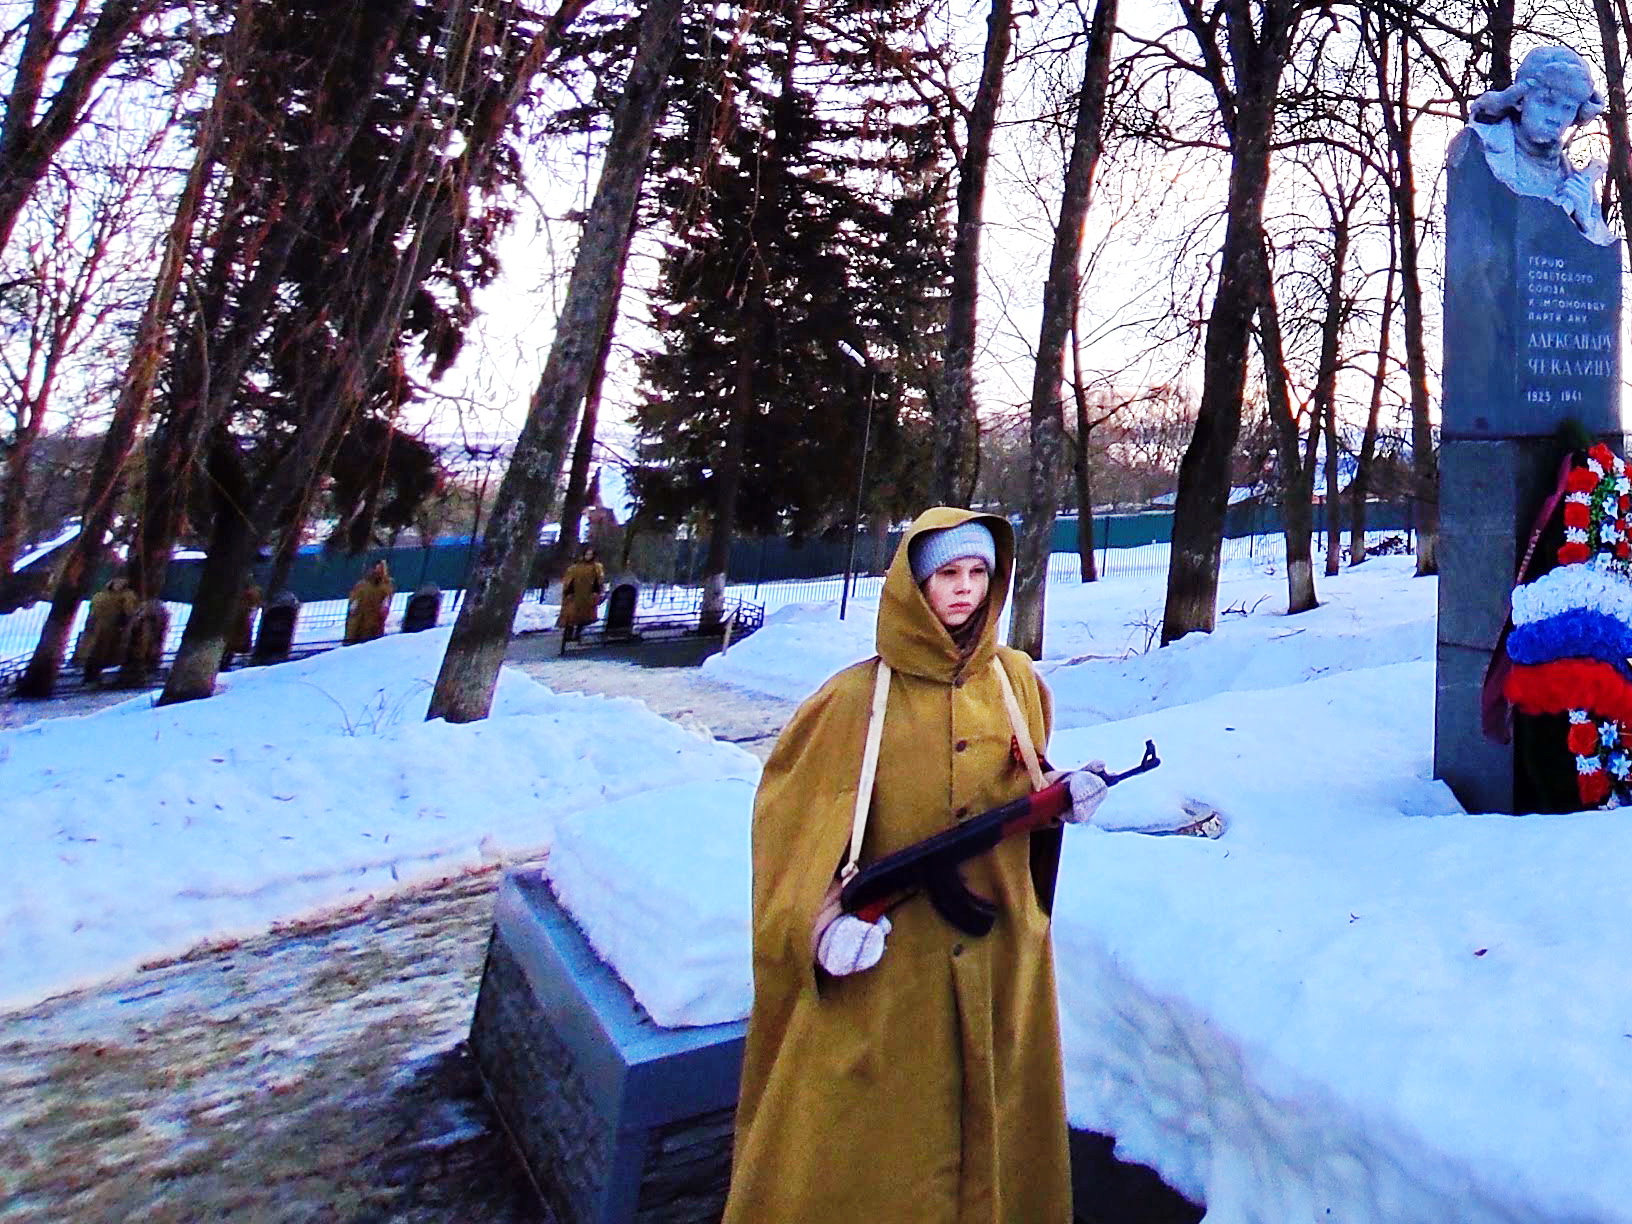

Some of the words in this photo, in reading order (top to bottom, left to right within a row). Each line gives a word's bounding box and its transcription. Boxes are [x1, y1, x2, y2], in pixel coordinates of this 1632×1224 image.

[1528, 283, 1565, 295] СОЮЗА
[1528, 298, 1606, 311] КМСОМОЛЬЦУ
[1528, 312, 1588, 323] ПАРТИАНУ
[1528, 332, 1612, 353] АЛЕКСАНДРУ
[1528, 358, 1614, 378] ЧЕКАЛИНУ
[1527, 390, 1551, 402] 1925
[1561, 390, 1582, 402] 1941
